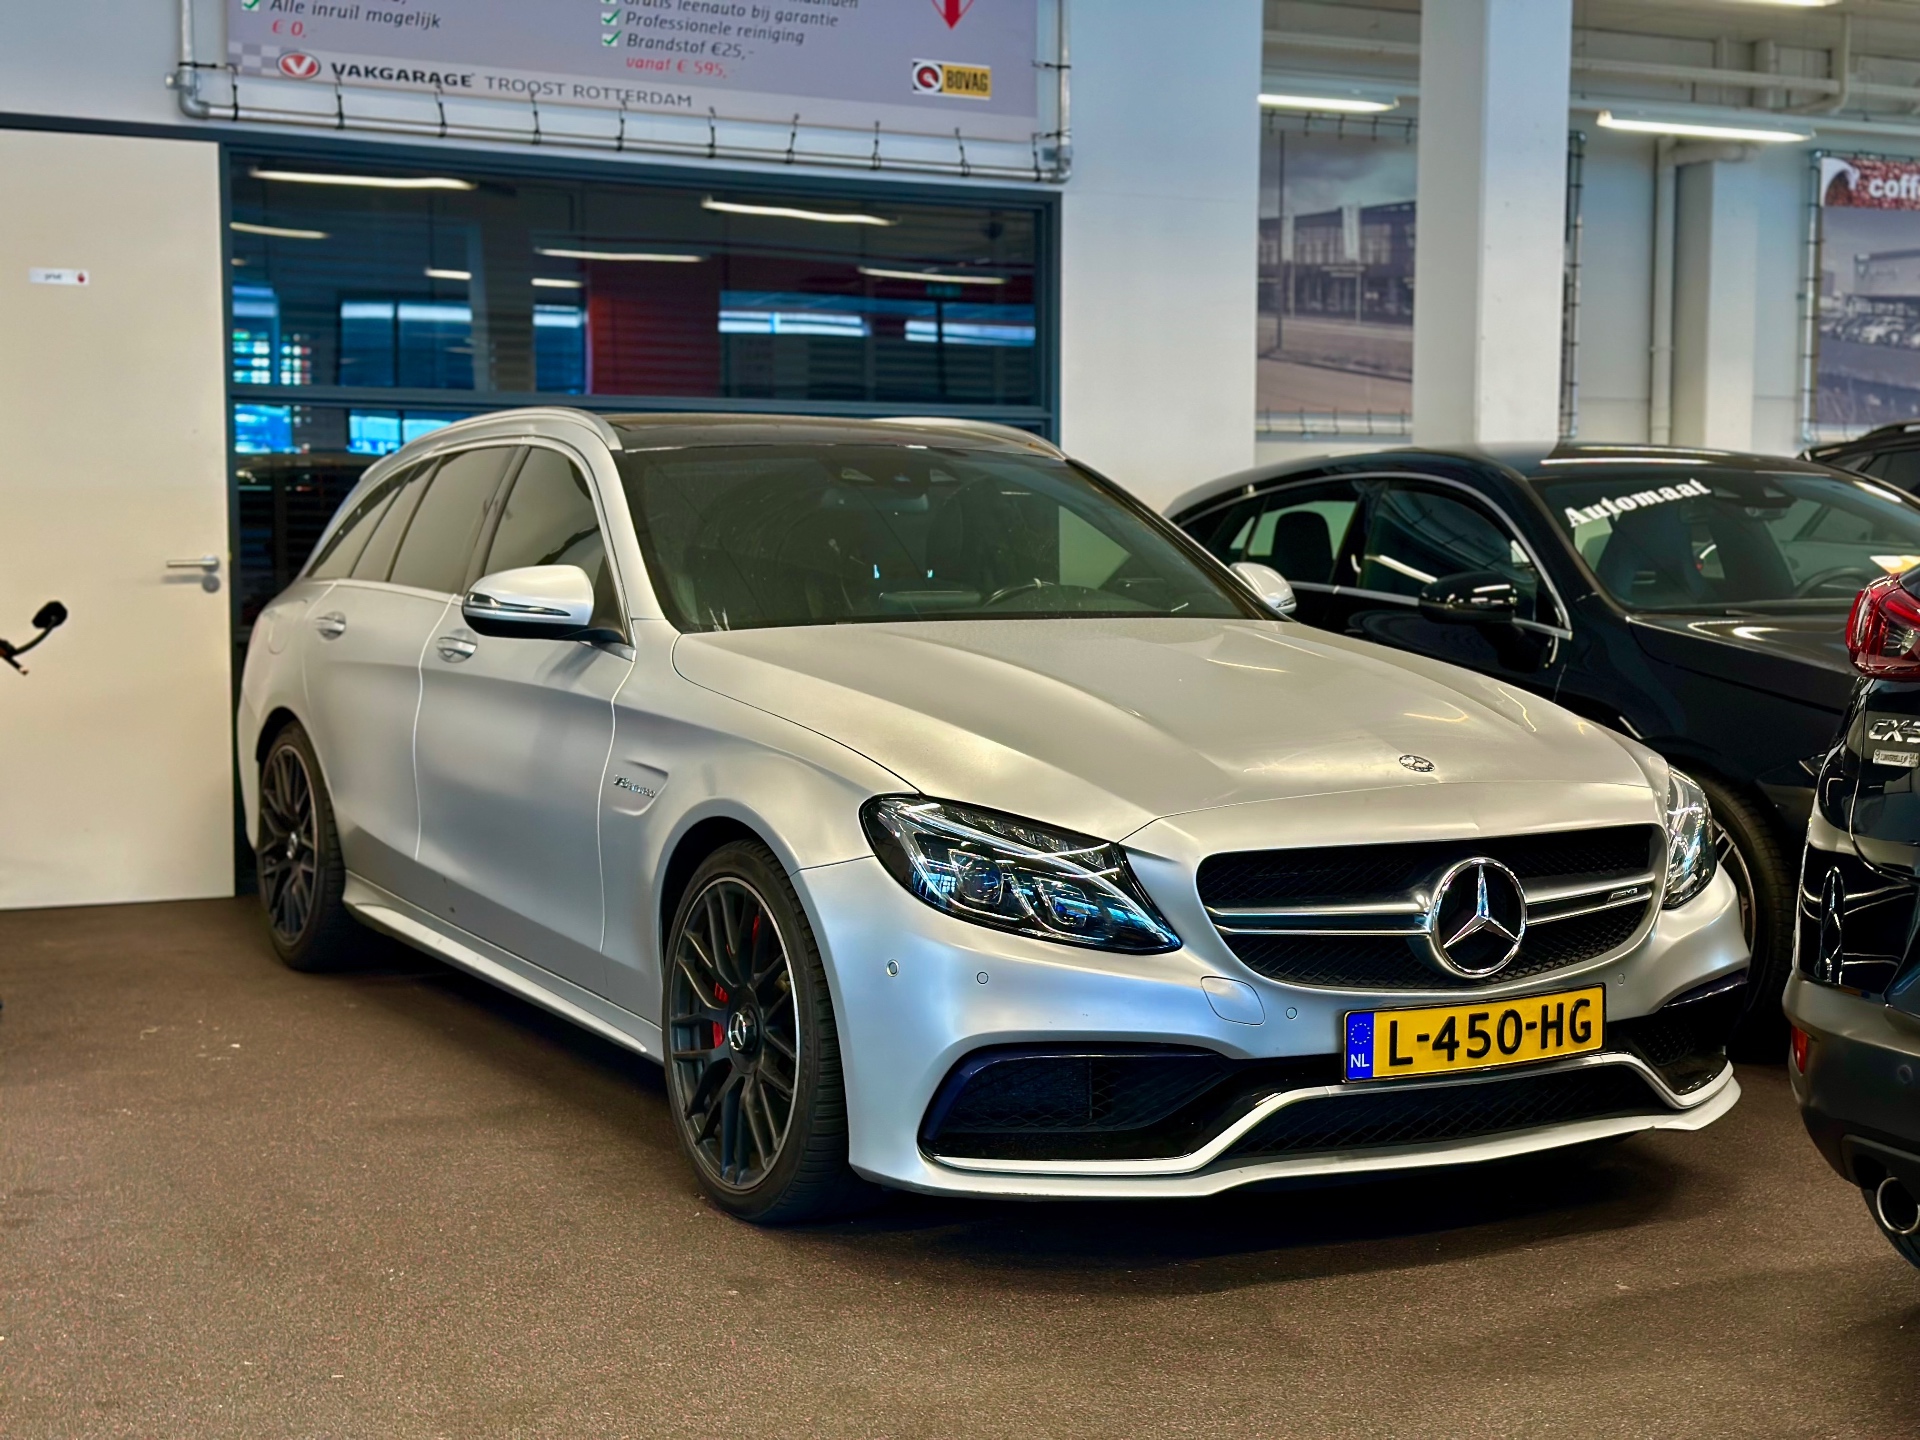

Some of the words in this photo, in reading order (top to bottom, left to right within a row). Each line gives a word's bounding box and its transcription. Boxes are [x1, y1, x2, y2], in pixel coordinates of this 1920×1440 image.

[270, 0, 305, 14] Alle
[312, 2, 360, 20] inruil
[366, 9, 441, 31] mogelijk
[677, 0, 746, 17] leenauto
[751, 5, 771, 23] bij
[774, 10, 839, 28] garantie
[625, 11, 732, 37] Professionele
[736, 25, 805, 46] reiniging
[627, 33, 706, 55] Brandstof
[626, 57, 671, 71] vanaf
[331, 62, 473, 87] VAKGARAGE
[484, 75, 566, 97] TROOST
[573, 84, 693, 108] ROTTERDAM
[946, 70, 989, 92] BOVAG
[1869, 173, 1920, 200] coff
[1564, 477, 1712, 528] Automaat
[1388, 998, 1592, 1067] L-450-HG
[1350, 1053, 1370, 1069] NL
